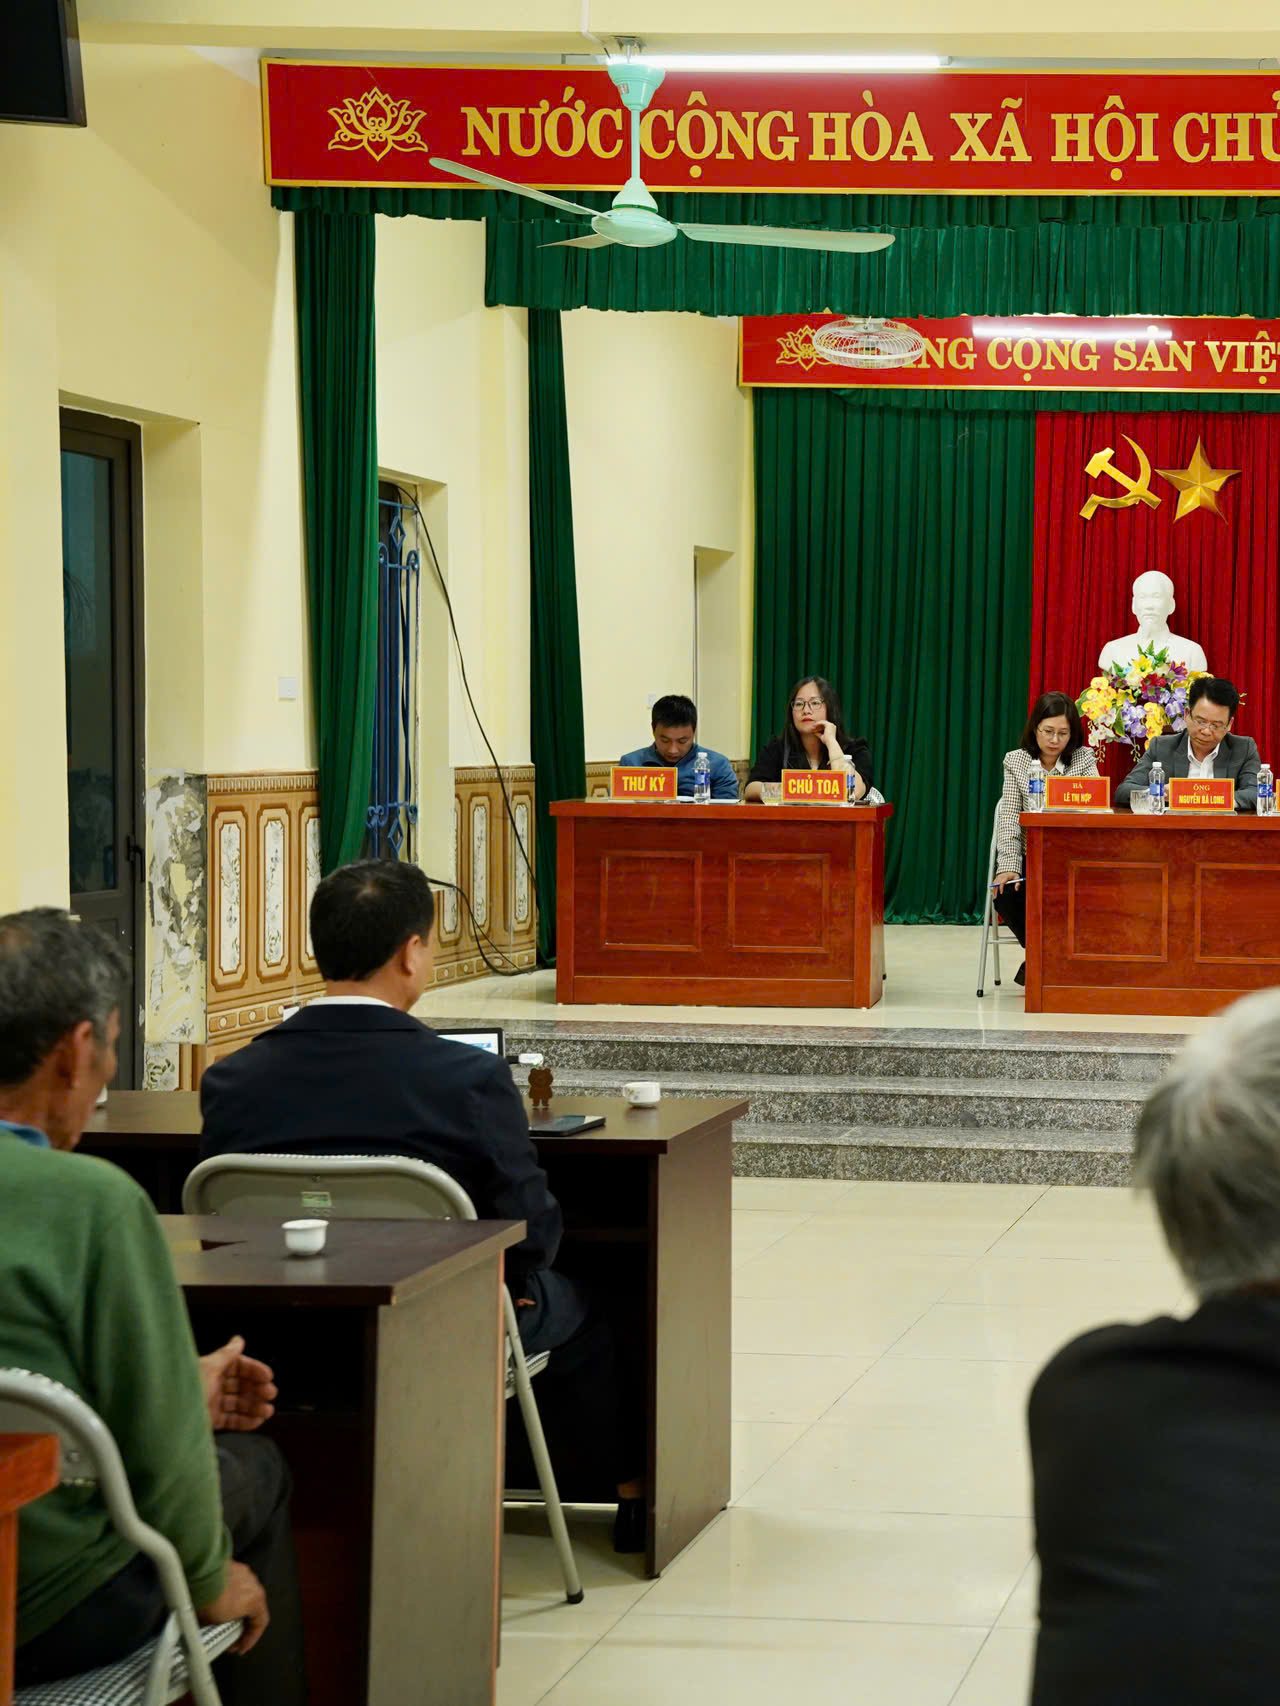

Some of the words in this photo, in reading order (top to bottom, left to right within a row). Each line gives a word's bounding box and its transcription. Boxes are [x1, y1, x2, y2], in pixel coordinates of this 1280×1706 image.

[461, 86, 624, 159] NƯỚC
[640, 91, 799, 178] CỘNG
[808, 89, 933, 162] HÒA
[950, 97, 1032, 162] XÃ
[1050, 95, 1159, 181] HỘI
[1113, 325, 1196, 372] SẢN
[622, 774, 648, 792] THƯ
[650, 773, 666, 792] KÝ
[788, 774, 813, 795] CHỦ
[816, 778, 840, 798] TOẠ
